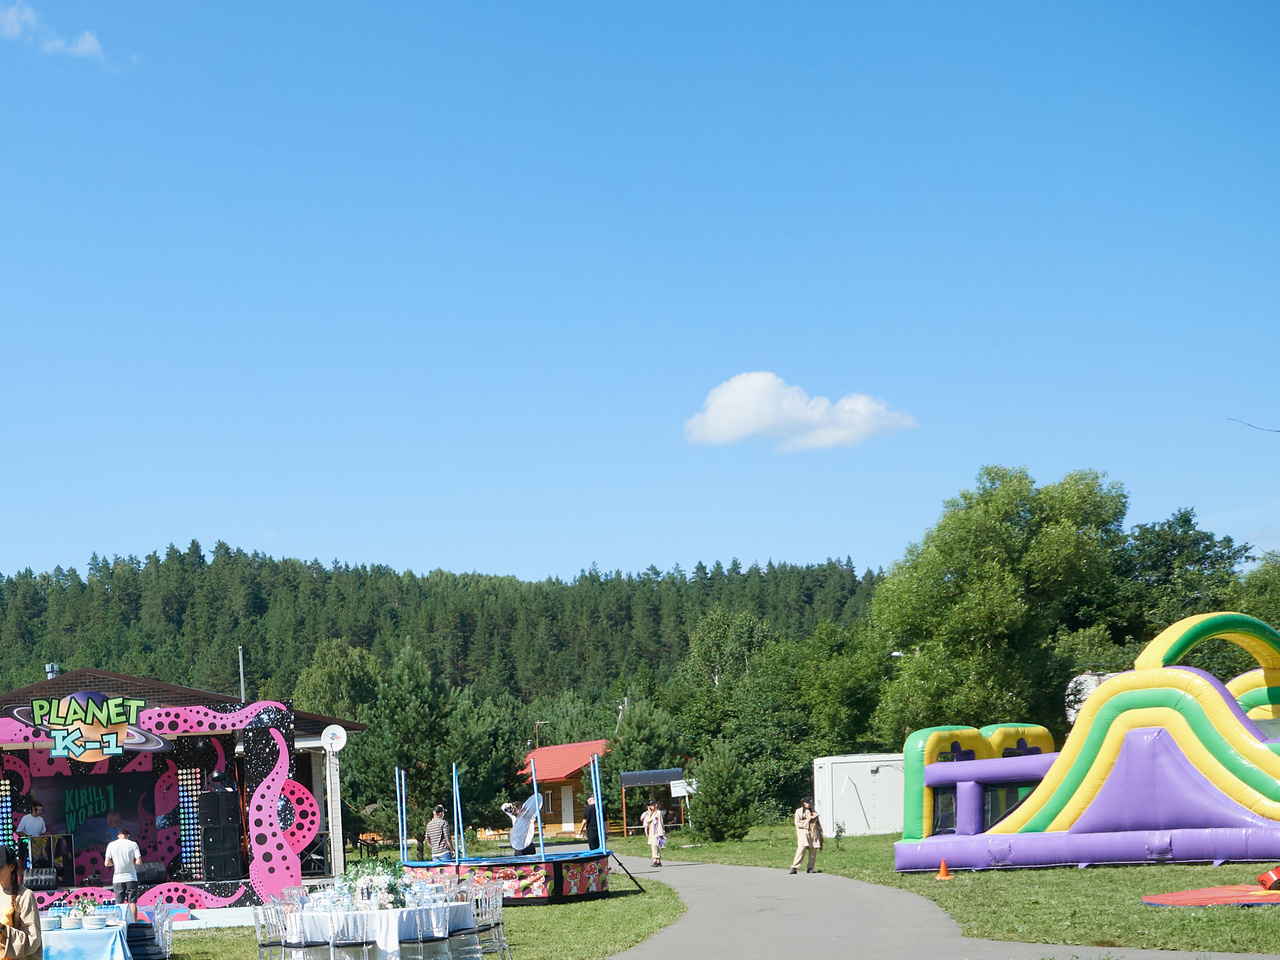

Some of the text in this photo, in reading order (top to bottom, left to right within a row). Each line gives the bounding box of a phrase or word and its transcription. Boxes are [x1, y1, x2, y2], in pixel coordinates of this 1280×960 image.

[31, 696, 147, 729] PLANET
[50, 727, 124, 759] K-1
[65, 784, 115, 812] KIRILL 1
[65, 800, 107, 834] WORLD
